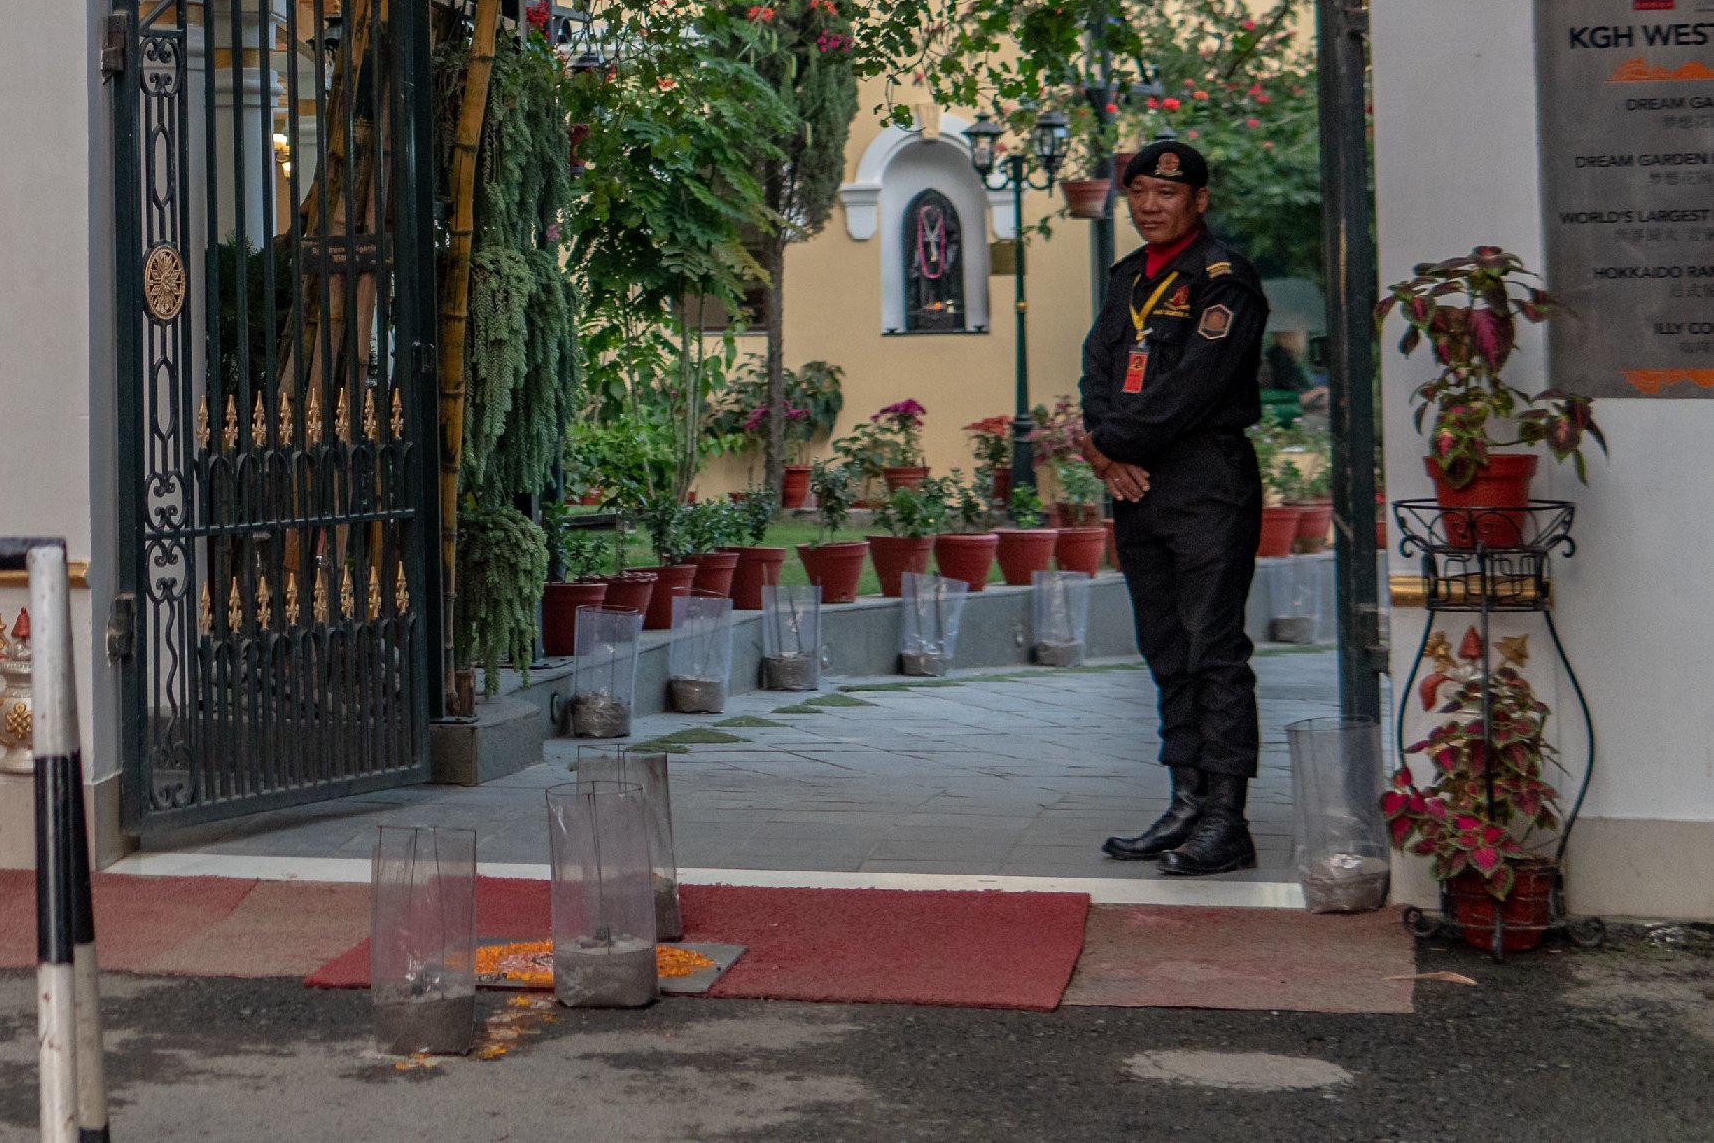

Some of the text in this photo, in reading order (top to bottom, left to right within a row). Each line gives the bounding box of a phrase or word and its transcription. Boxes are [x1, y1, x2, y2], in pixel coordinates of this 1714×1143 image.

[1570, 25, 1632, 48] KGH
[1626, 97, 1685, 111] DREAM
[1638, 153, 1708, 166] GARDEN
[1638, 209, 1711, 222] LARGEST
[1593, 266, 1682, 279] HOKKAIDO
